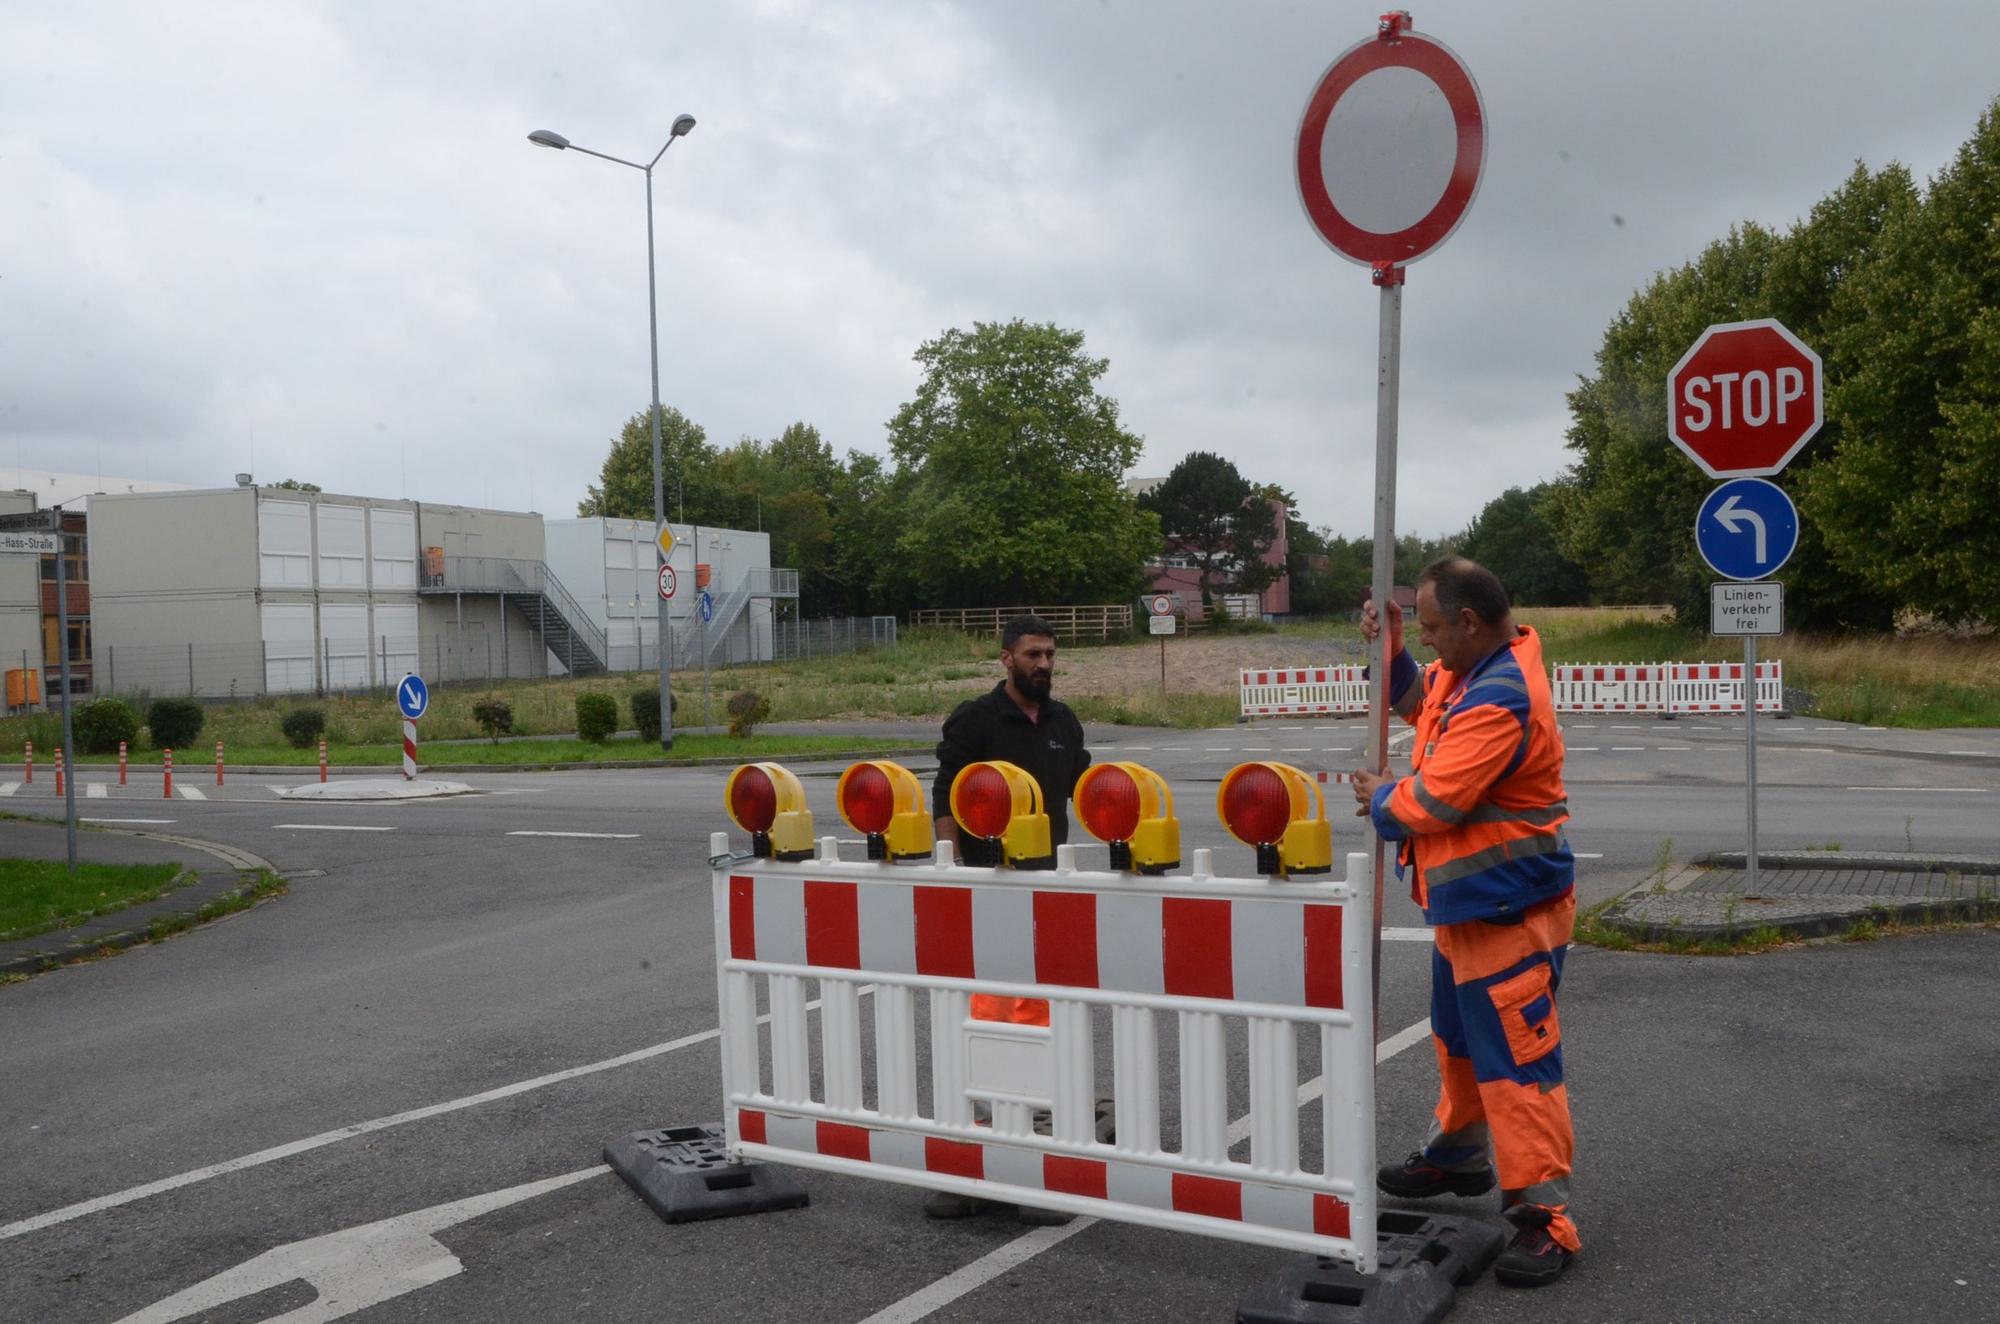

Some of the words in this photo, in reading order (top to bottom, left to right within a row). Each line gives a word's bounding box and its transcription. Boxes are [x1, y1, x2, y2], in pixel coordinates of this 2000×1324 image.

[1684, 366, 1804, 432] STOP
[0, 536, 54, 550] -Hass-Straße
[662, 574, 673, 590] 30
[1724, 588, 1769, 601] Linien-
[1722, 603, 1772, 615] verkehr
[1736, 617, 1758, 629] frei
